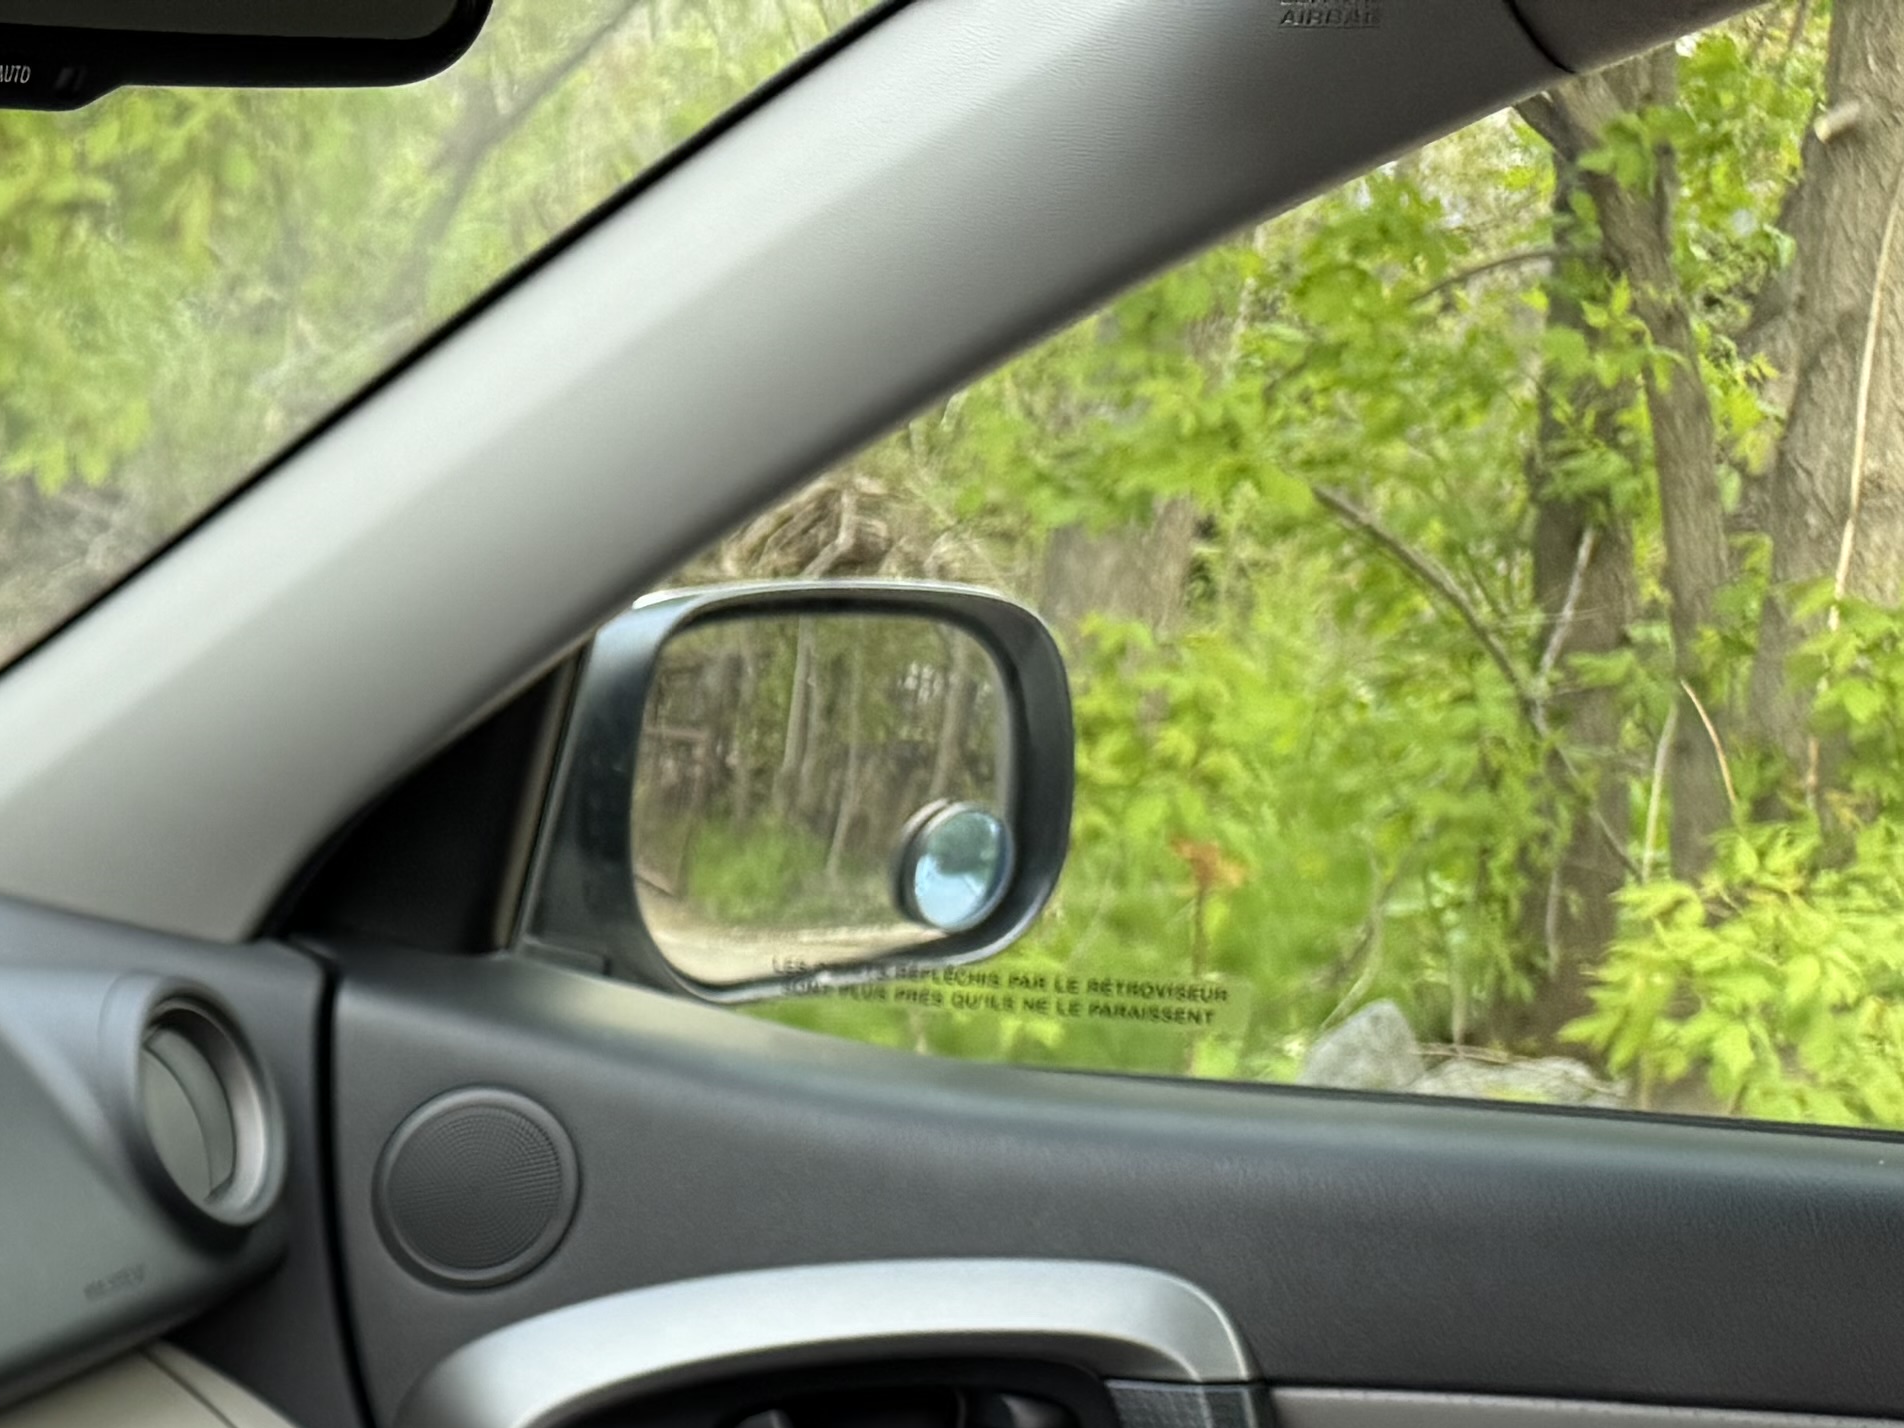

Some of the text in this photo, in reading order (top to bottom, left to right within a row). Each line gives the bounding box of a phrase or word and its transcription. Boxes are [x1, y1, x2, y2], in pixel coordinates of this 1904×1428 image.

[1008, 971, 1046, 990] PAR
[1054, 976, 1079, 995] LE
[838, 983, 886, 1000] PLUS
[1022, 998, 1049, 1015] NE
[1056, 1000, 1081, 1017] LE
[1088, 1002, 1215, 1025] PARAISSENT
